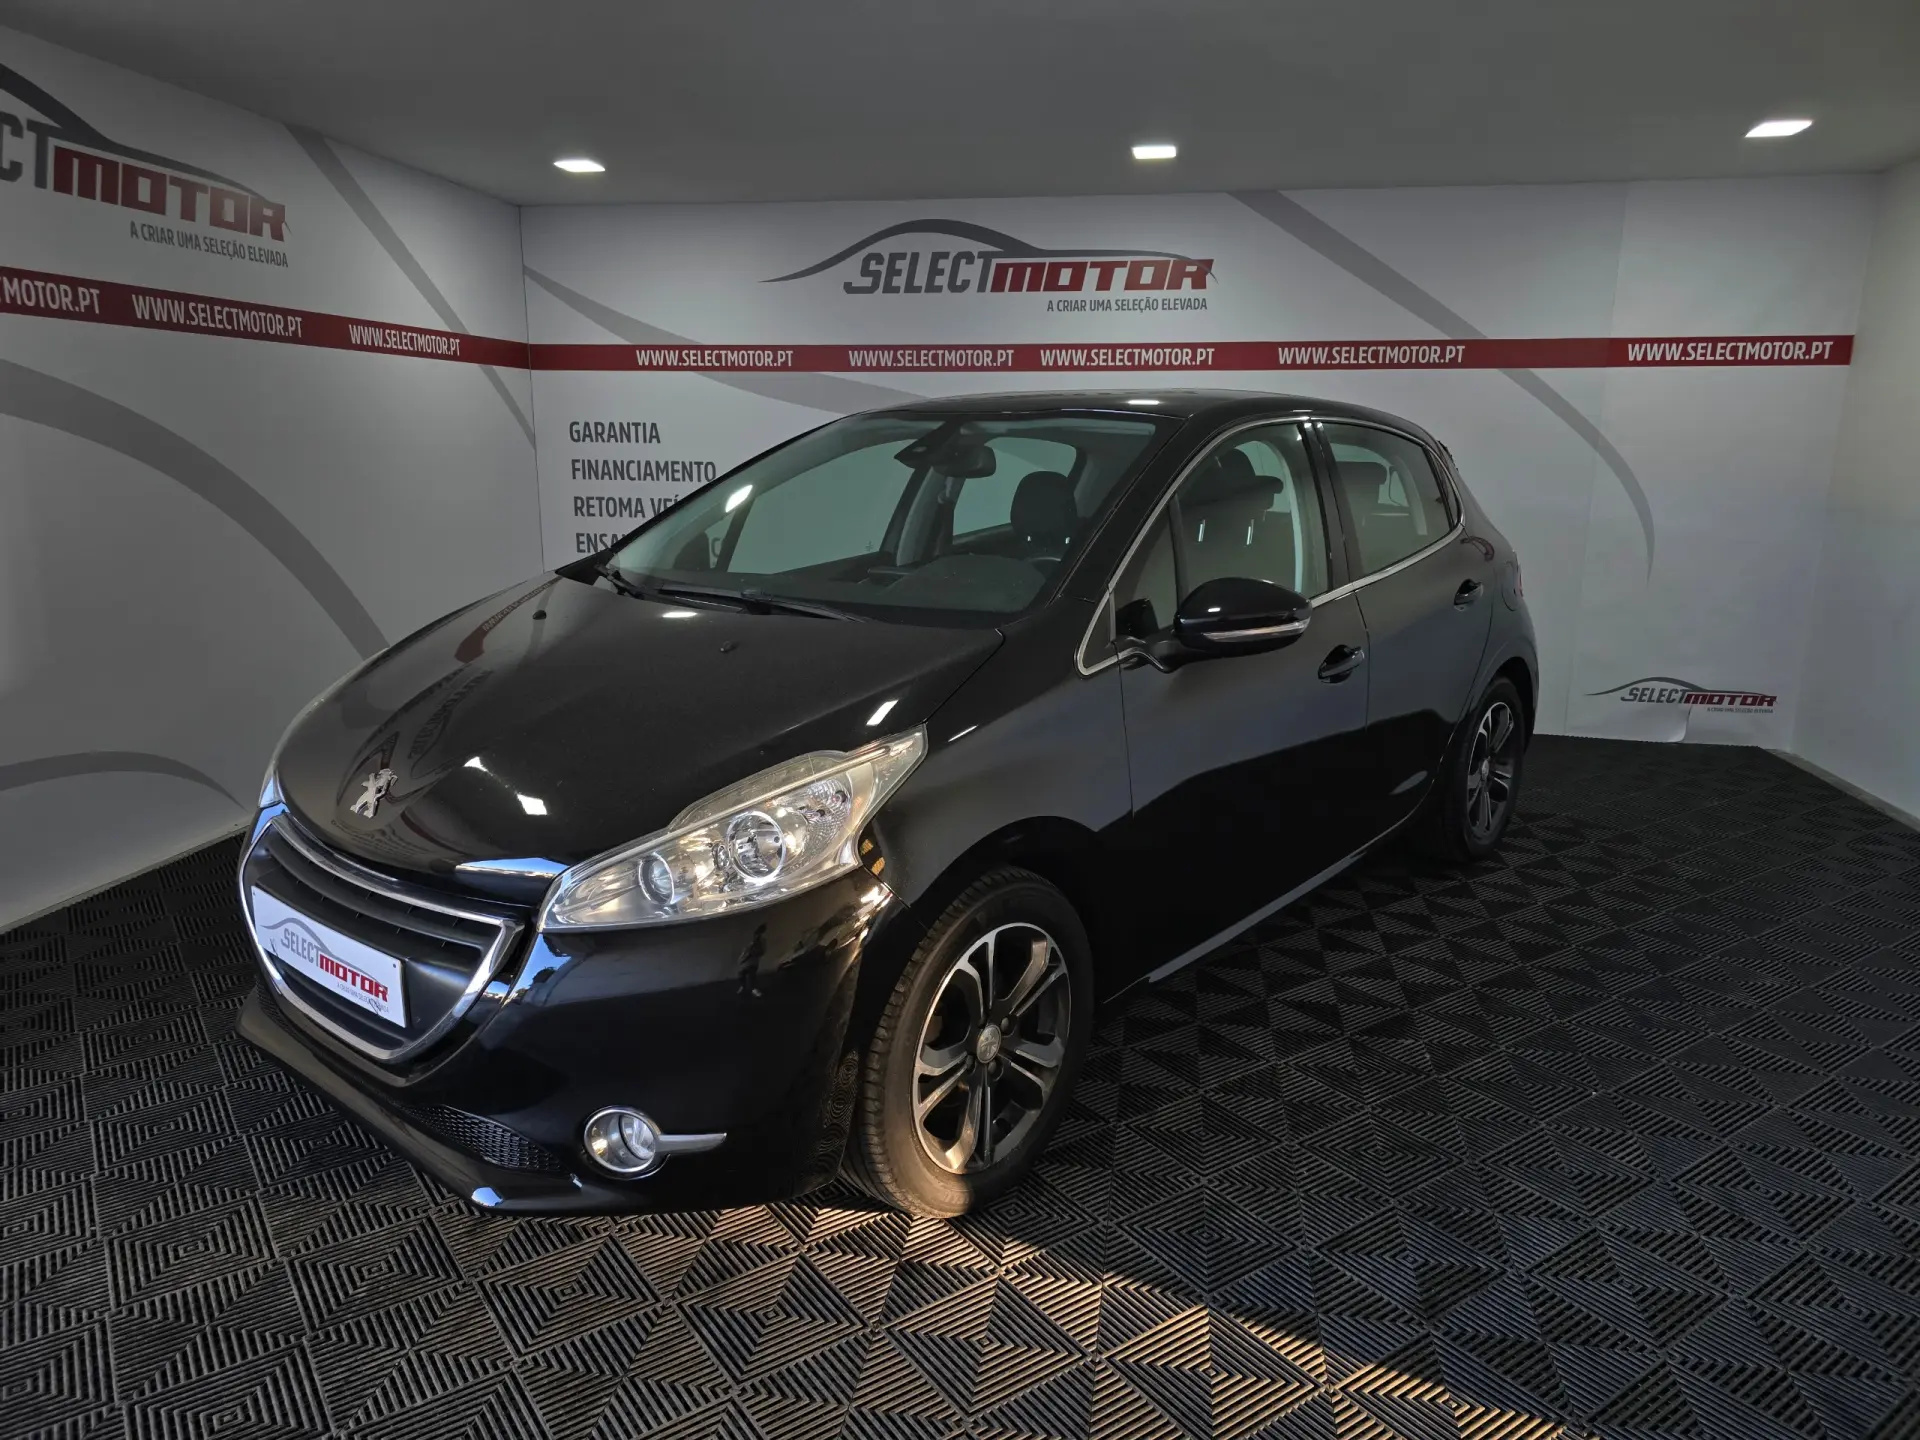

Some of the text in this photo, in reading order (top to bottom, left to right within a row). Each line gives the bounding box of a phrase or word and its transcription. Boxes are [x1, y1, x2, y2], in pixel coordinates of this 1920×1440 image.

[130, 220, 289, 268] A CRIAR UMA SELEÇÃO ELEVADA
[0, 276, 100, 314] MOTOR.PT
[1047, 297, 1208, 313] A CRIAR UMA SELEÇÃO ELEVADA
[132, 294, 303, 338] WWW.SELECTMOTOR.PT
[349, 324, 460, 356] WWW.SELECTMOTOR.PT
[1628, 341, 1833, 361] WWW.SELECTMOTOR.PT
[636, 350, 793, 367] WWW.SELECTMOTOR.PT
[849, 350, 1014, 367] WWW.SELECTMOTOR.PT
[1040, 348, 1215, 366] WWW.SELECTMOTOR.PT
[1278, 345, 1465, 365] WWW.SELECTMOTOR.PT
[569, 421, 661, 444] GARANTIA
[571, 459, 717, 482] FINANCIAMENTO
[573, 496, 646, 518] RETOMA
